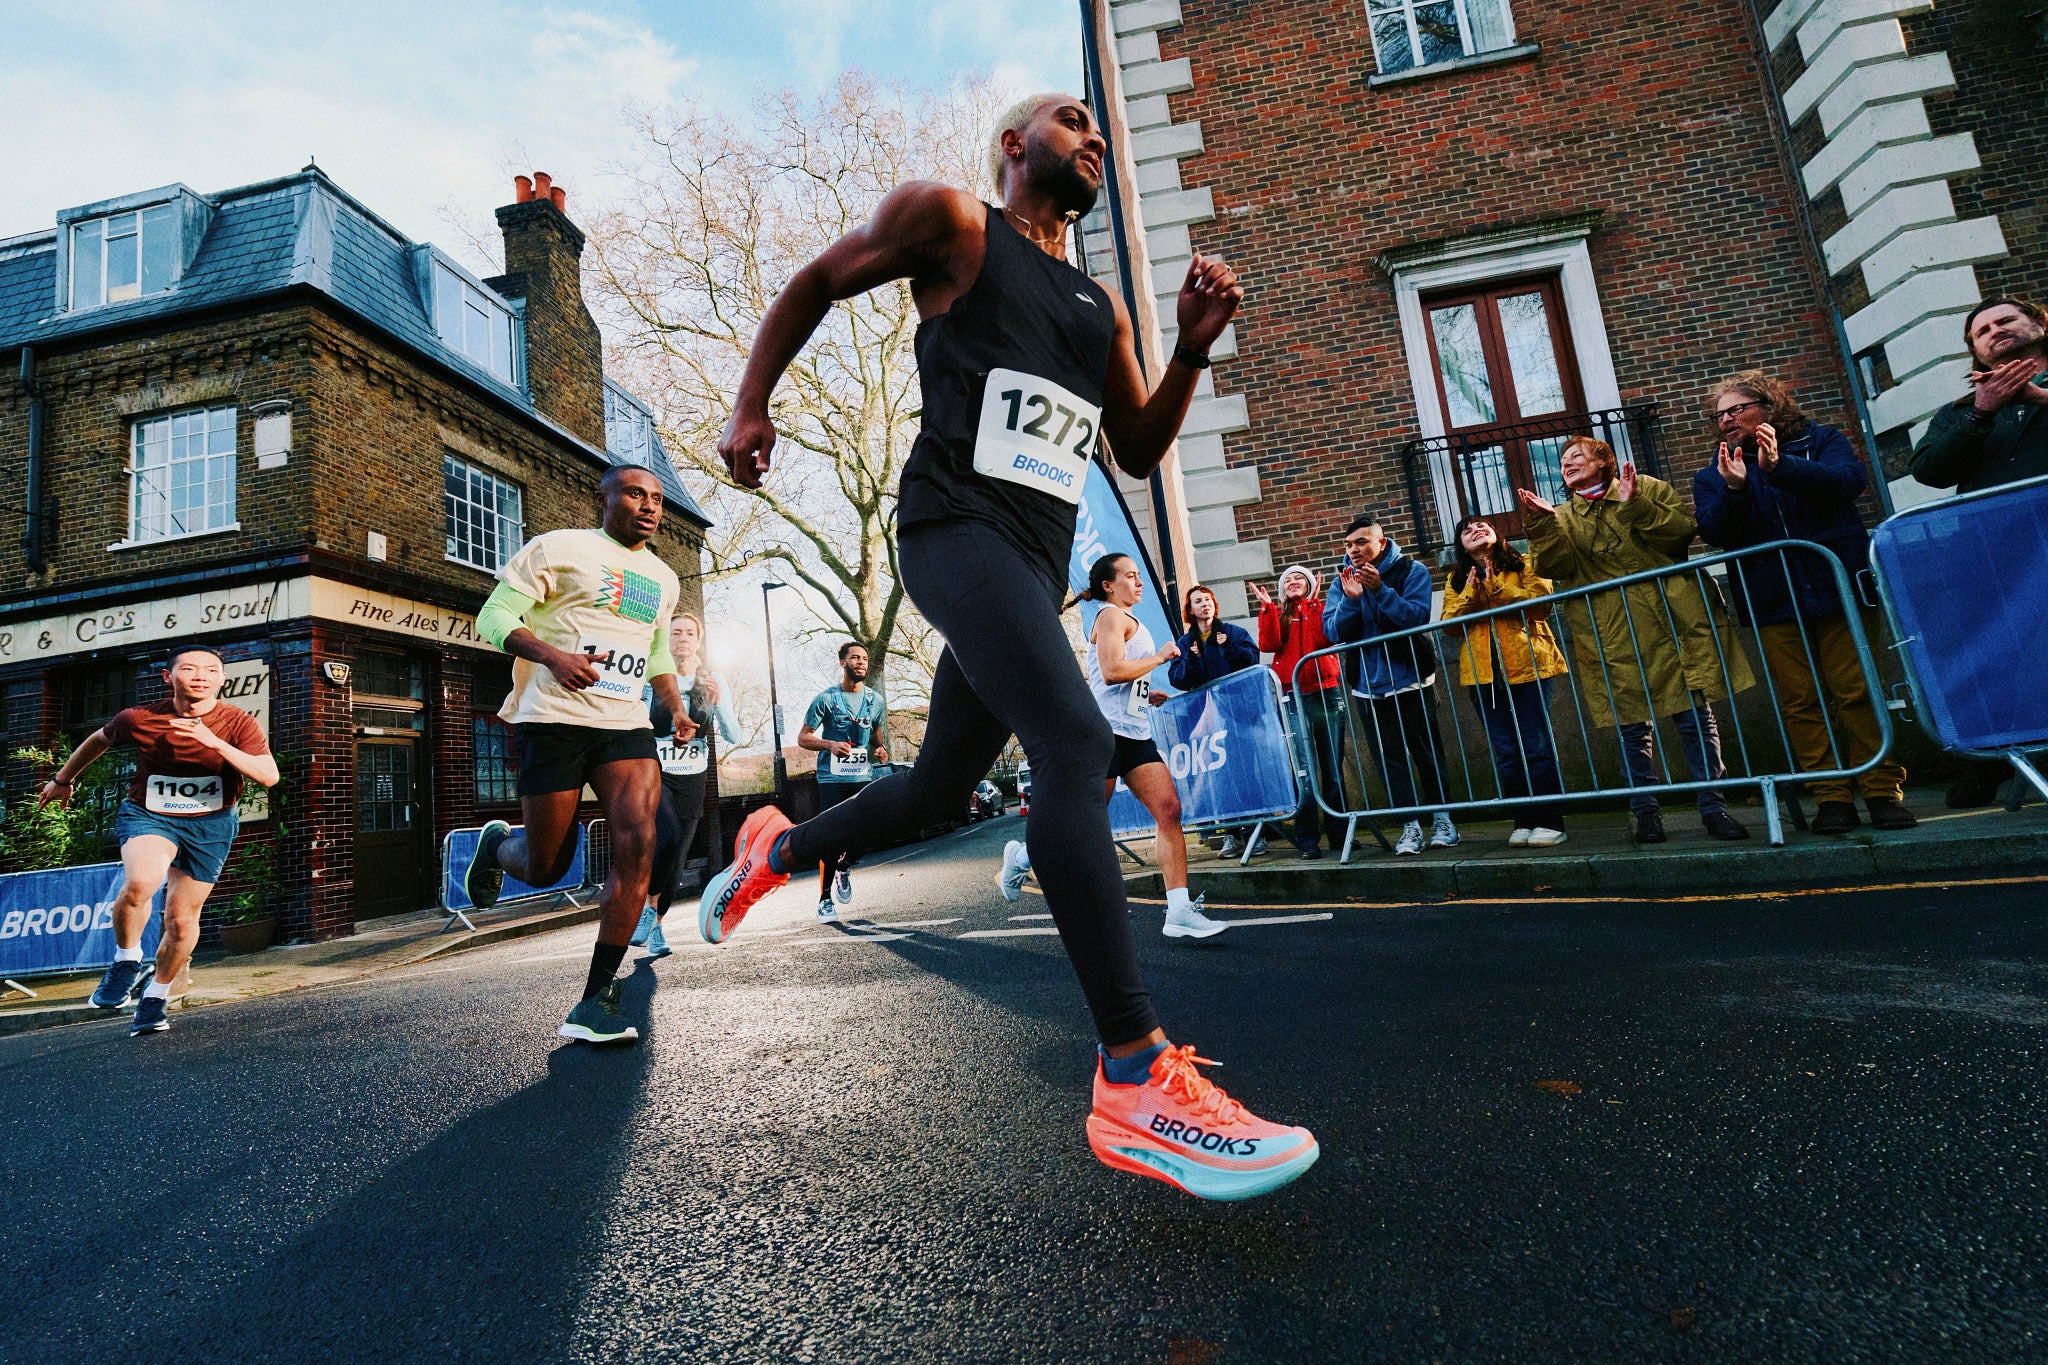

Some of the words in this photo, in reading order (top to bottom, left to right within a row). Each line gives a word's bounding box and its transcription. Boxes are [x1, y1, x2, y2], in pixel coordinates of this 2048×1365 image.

[1001, 389, 1093, 462] 1272
[1012, 454, 1074, 488] BROOKS
[622, 585, 660, 610] BROOKS
[0, 632, 12, 656] R
[38, 631, 52, 650] &
[164, 613, 178, 629] &
[200, 596, 271, 624] Stout
[349, 599, 394, 623] Fine
[396, 612, 439, 633] Ales
[446, 616, 492, 644] TA
[216, 672, 269, 700] RLEY
[593, 680, 631, 694] BROOKS
[1136, 680, 1150, 699] 13
[660, 745, 700, 761] 1178
[837, 752, 867, 764] 1235
[154, 780, 220, 798] 1104
[163, 801, 208, 810] BROOKS
[714, 859, 753, 922] BROOKS
[1150, 1113, 1262, 1156] BROOKS
